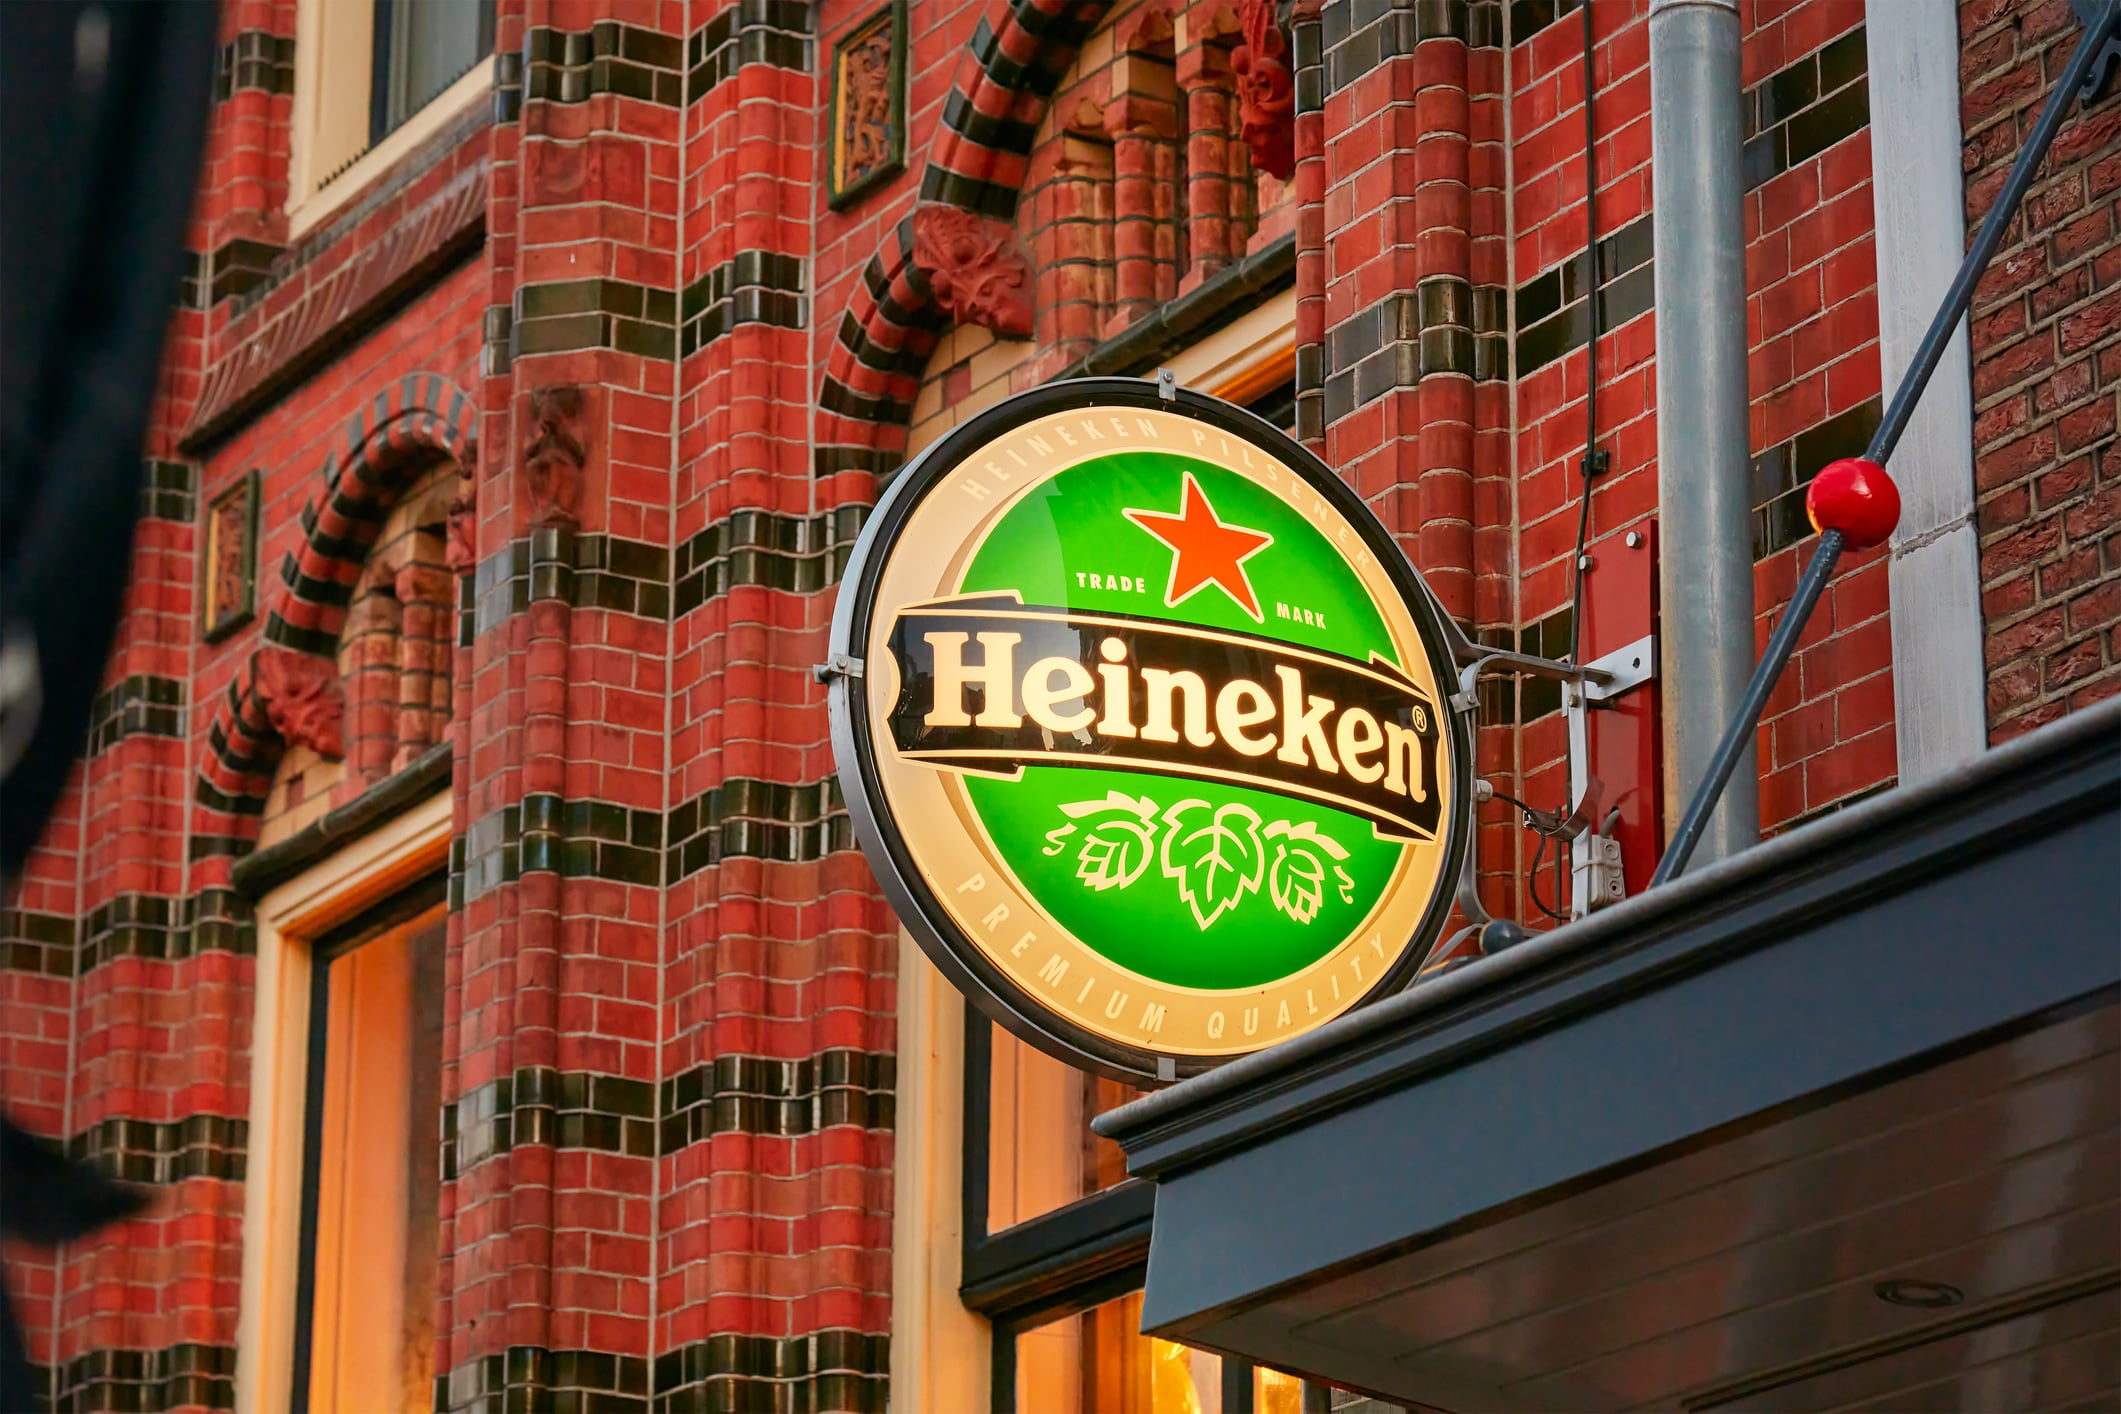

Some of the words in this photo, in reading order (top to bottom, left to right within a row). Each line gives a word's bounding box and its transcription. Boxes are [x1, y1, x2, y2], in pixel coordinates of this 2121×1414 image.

[960, 416, 1157, 501] HEINEKEN
[1193, 429, 1373, 570] PILSENER
[1076, 571, 1146, 595] TRADE
[1276, 601, 1327, 630] MARK
[956, 872, 1168, 1034] PREMIUM
[1207, 932, 1389, 1039] QUALITY
